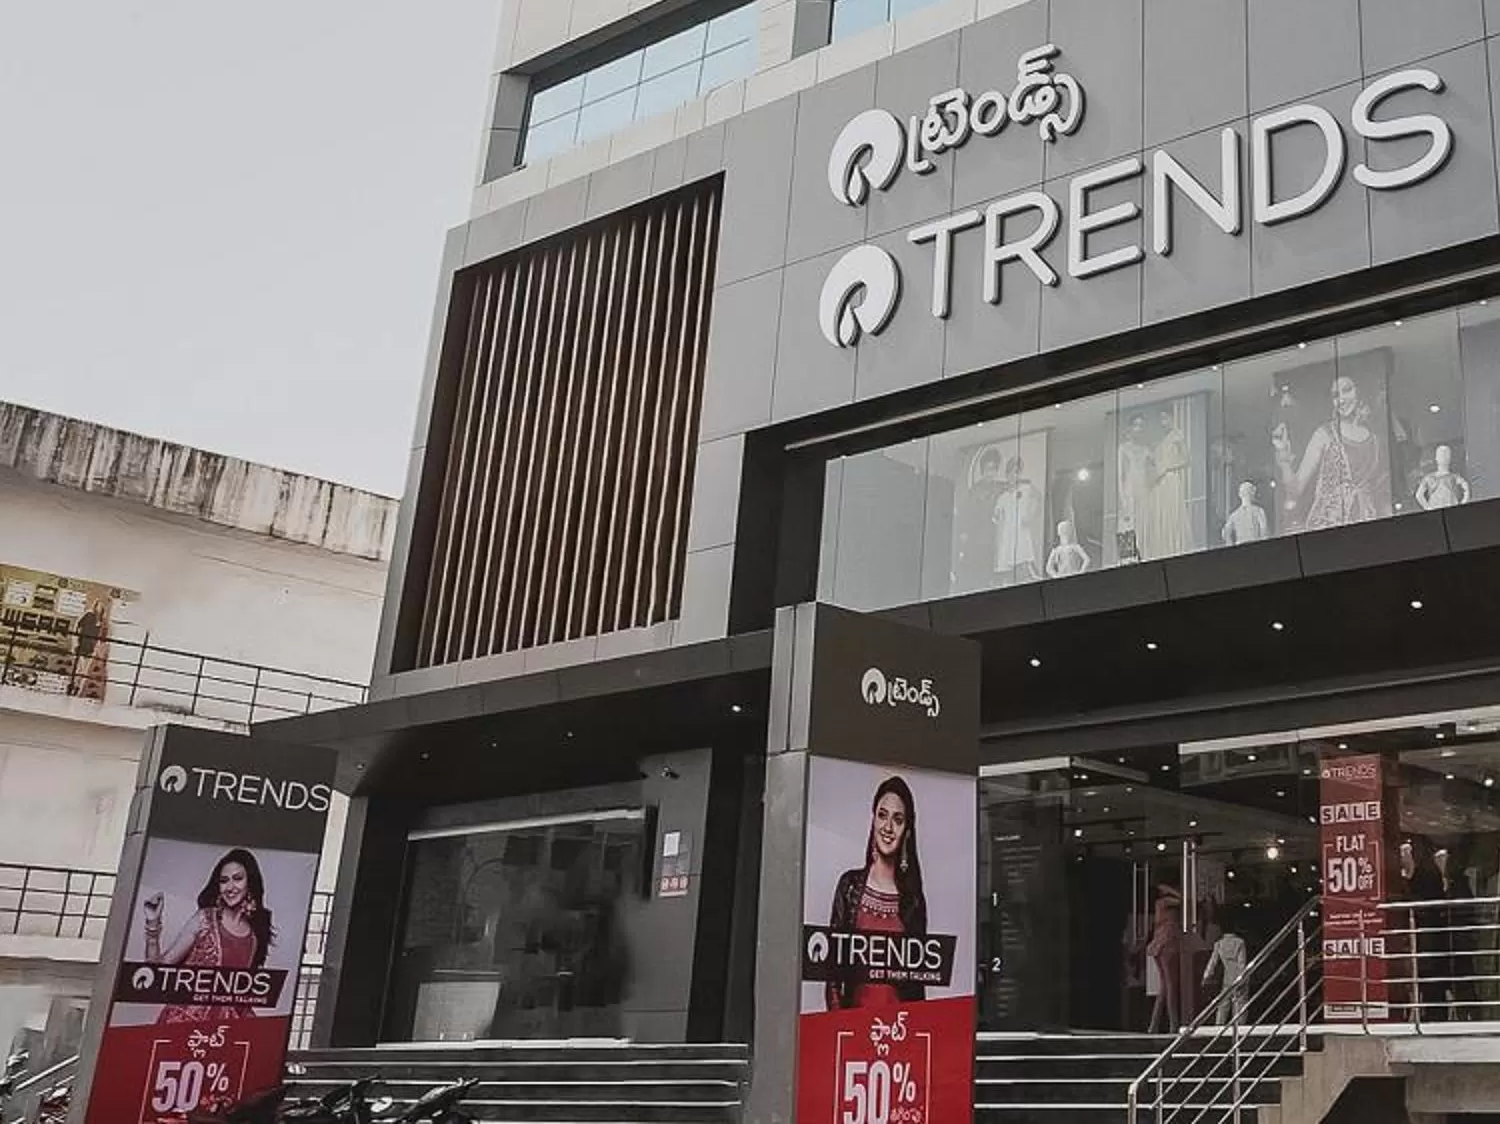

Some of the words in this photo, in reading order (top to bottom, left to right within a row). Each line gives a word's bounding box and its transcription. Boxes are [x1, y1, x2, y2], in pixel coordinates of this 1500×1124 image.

[907, 69, 1453, 319] TRENDS
[192, 767, 331, 812] TRENDS
[1322, 803, 1378, 822] SALE
[1336, 834, 1366, 853] FLAT
[1328, 856, 1373, 893] 50%
[831, 933, 942, 969] TRENDS
[992, 957, 1001, 972] 2
[158, 967, 271, 995] TRENDS
[869, 969, 885, 979] GET
[151, 1061, 229, 1112] 50%
[843, 1059, 916, 1124] 50%
